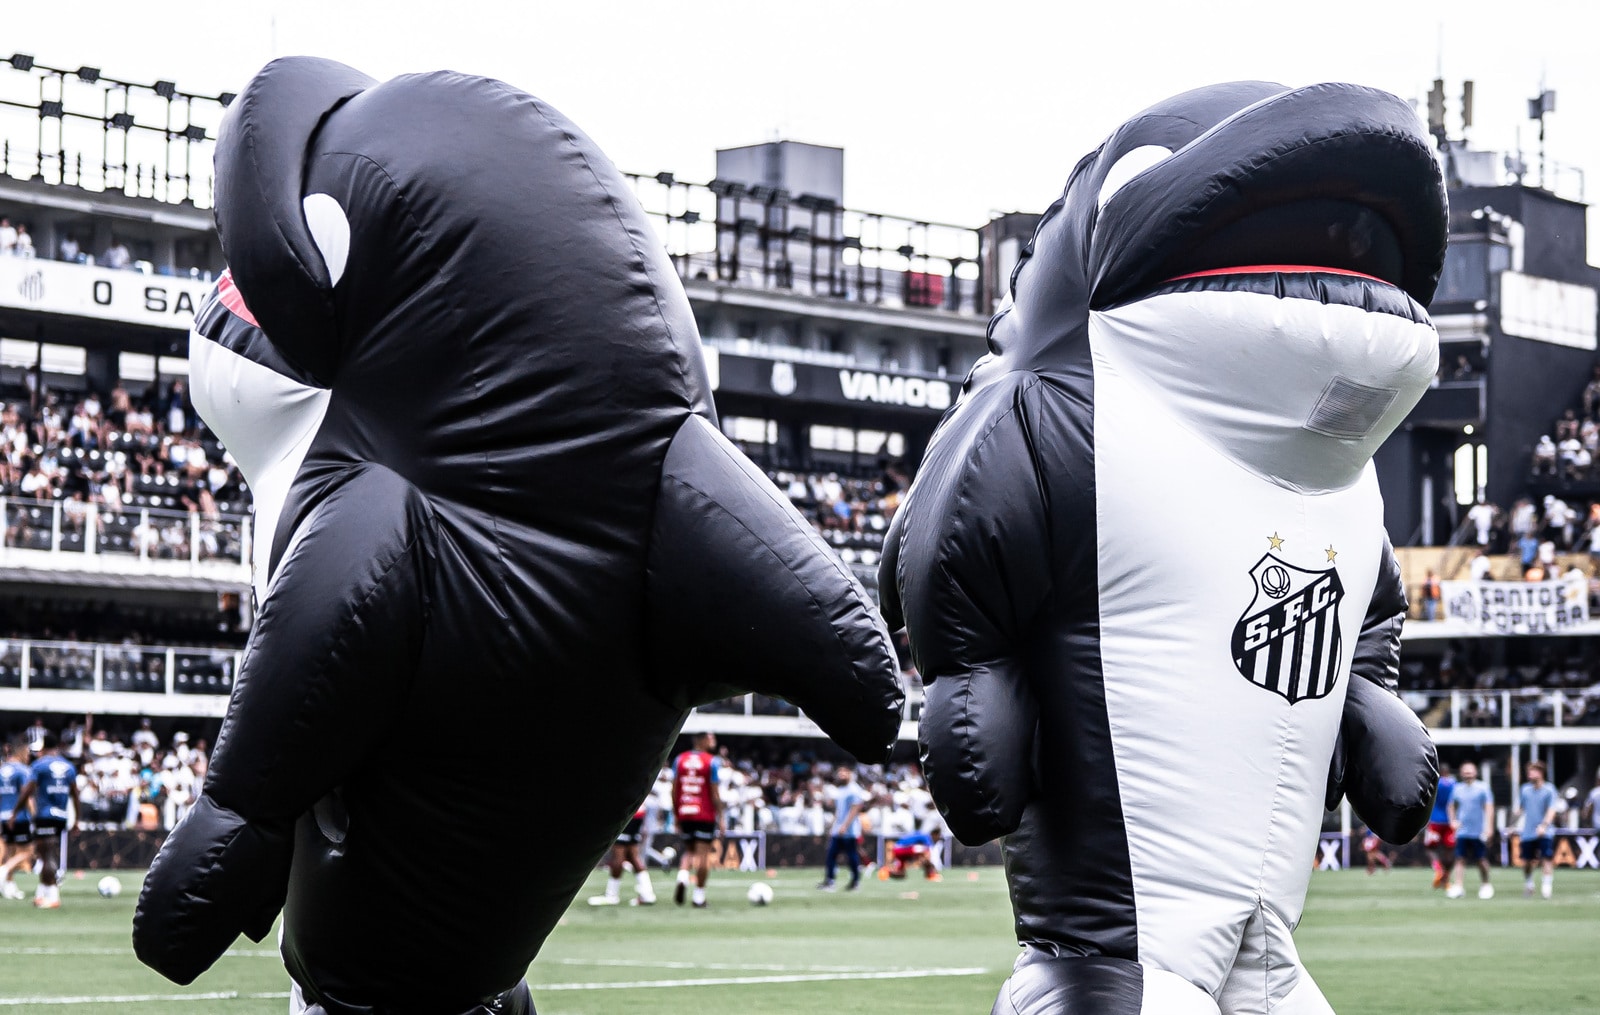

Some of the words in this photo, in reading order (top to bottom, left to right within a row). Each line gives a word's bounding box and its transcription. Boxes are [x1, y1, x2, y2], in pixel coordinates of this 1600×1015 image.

[93, 280, 113, 306] O
[144, 286, 206, 315] SA
[839, 369, 951, 410] VAMOS
[1244, 576, 1337, 651] S.F.C.
